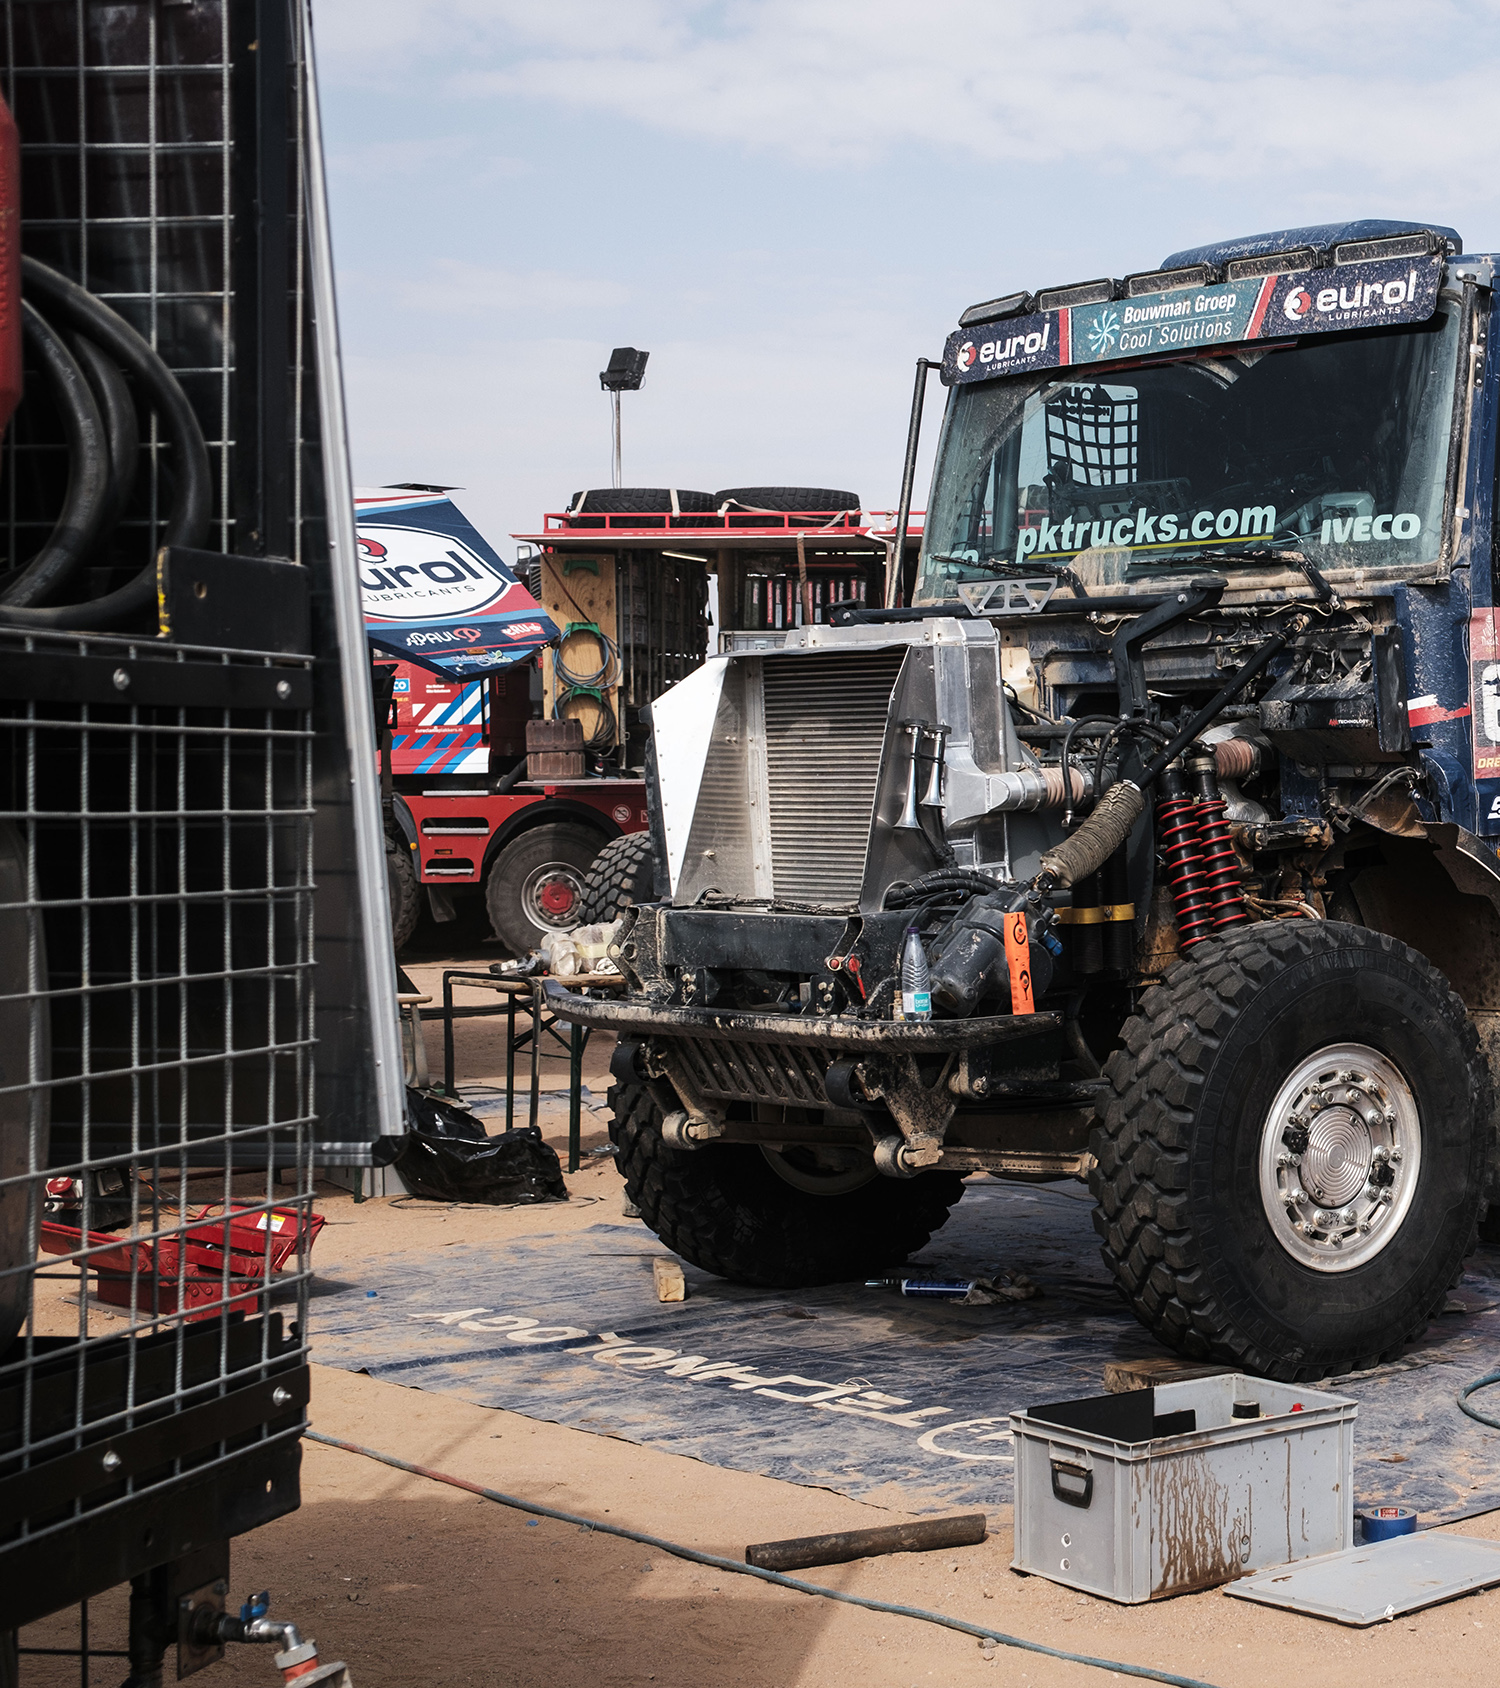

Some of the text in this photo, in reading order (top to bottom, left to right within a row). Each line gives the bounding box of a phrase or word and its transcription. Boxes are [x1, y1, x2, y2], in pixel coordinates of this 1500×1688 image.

[1317, 270, 1417, 311] eurol
[1124, 293, 1237, 324] Bouwman Groep
[1328, 306, 1401, 321] LUBRICANTS
[979, 323, 1050, 363] eurol
[1119, 320, 1232, 351] Cool Solutions
[986, 355, 1037, 371] LUBRICANTS
[1016, 505, 1277, 564] pktrucks.com
[1321, 513, 1421, 544] IVECO
[360, 551, 484, 591] urol
